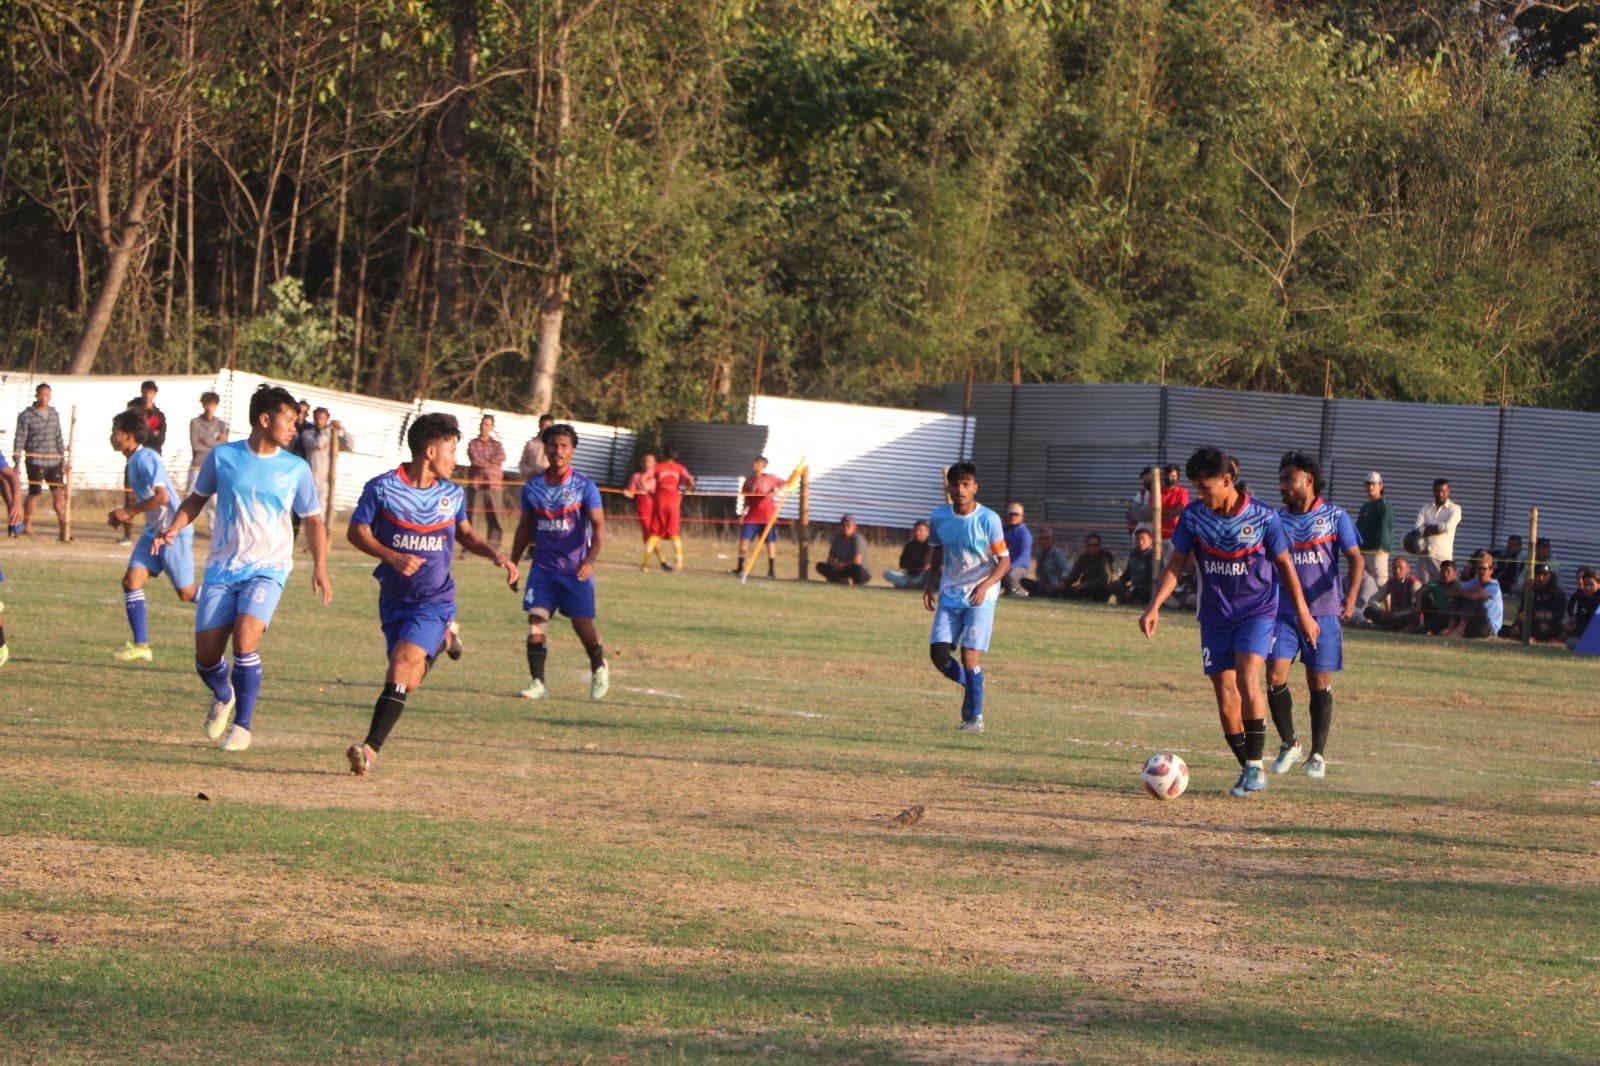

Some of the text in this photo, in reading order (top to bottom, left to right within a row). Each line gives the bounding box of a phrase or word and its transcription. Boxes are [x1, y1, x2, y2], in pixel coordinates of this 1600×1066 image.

[392, 533, 443, 552] SAHARA
[1204, 560, 1249, 576] SAHARA
[1203, 646, 1213, 667] 2
